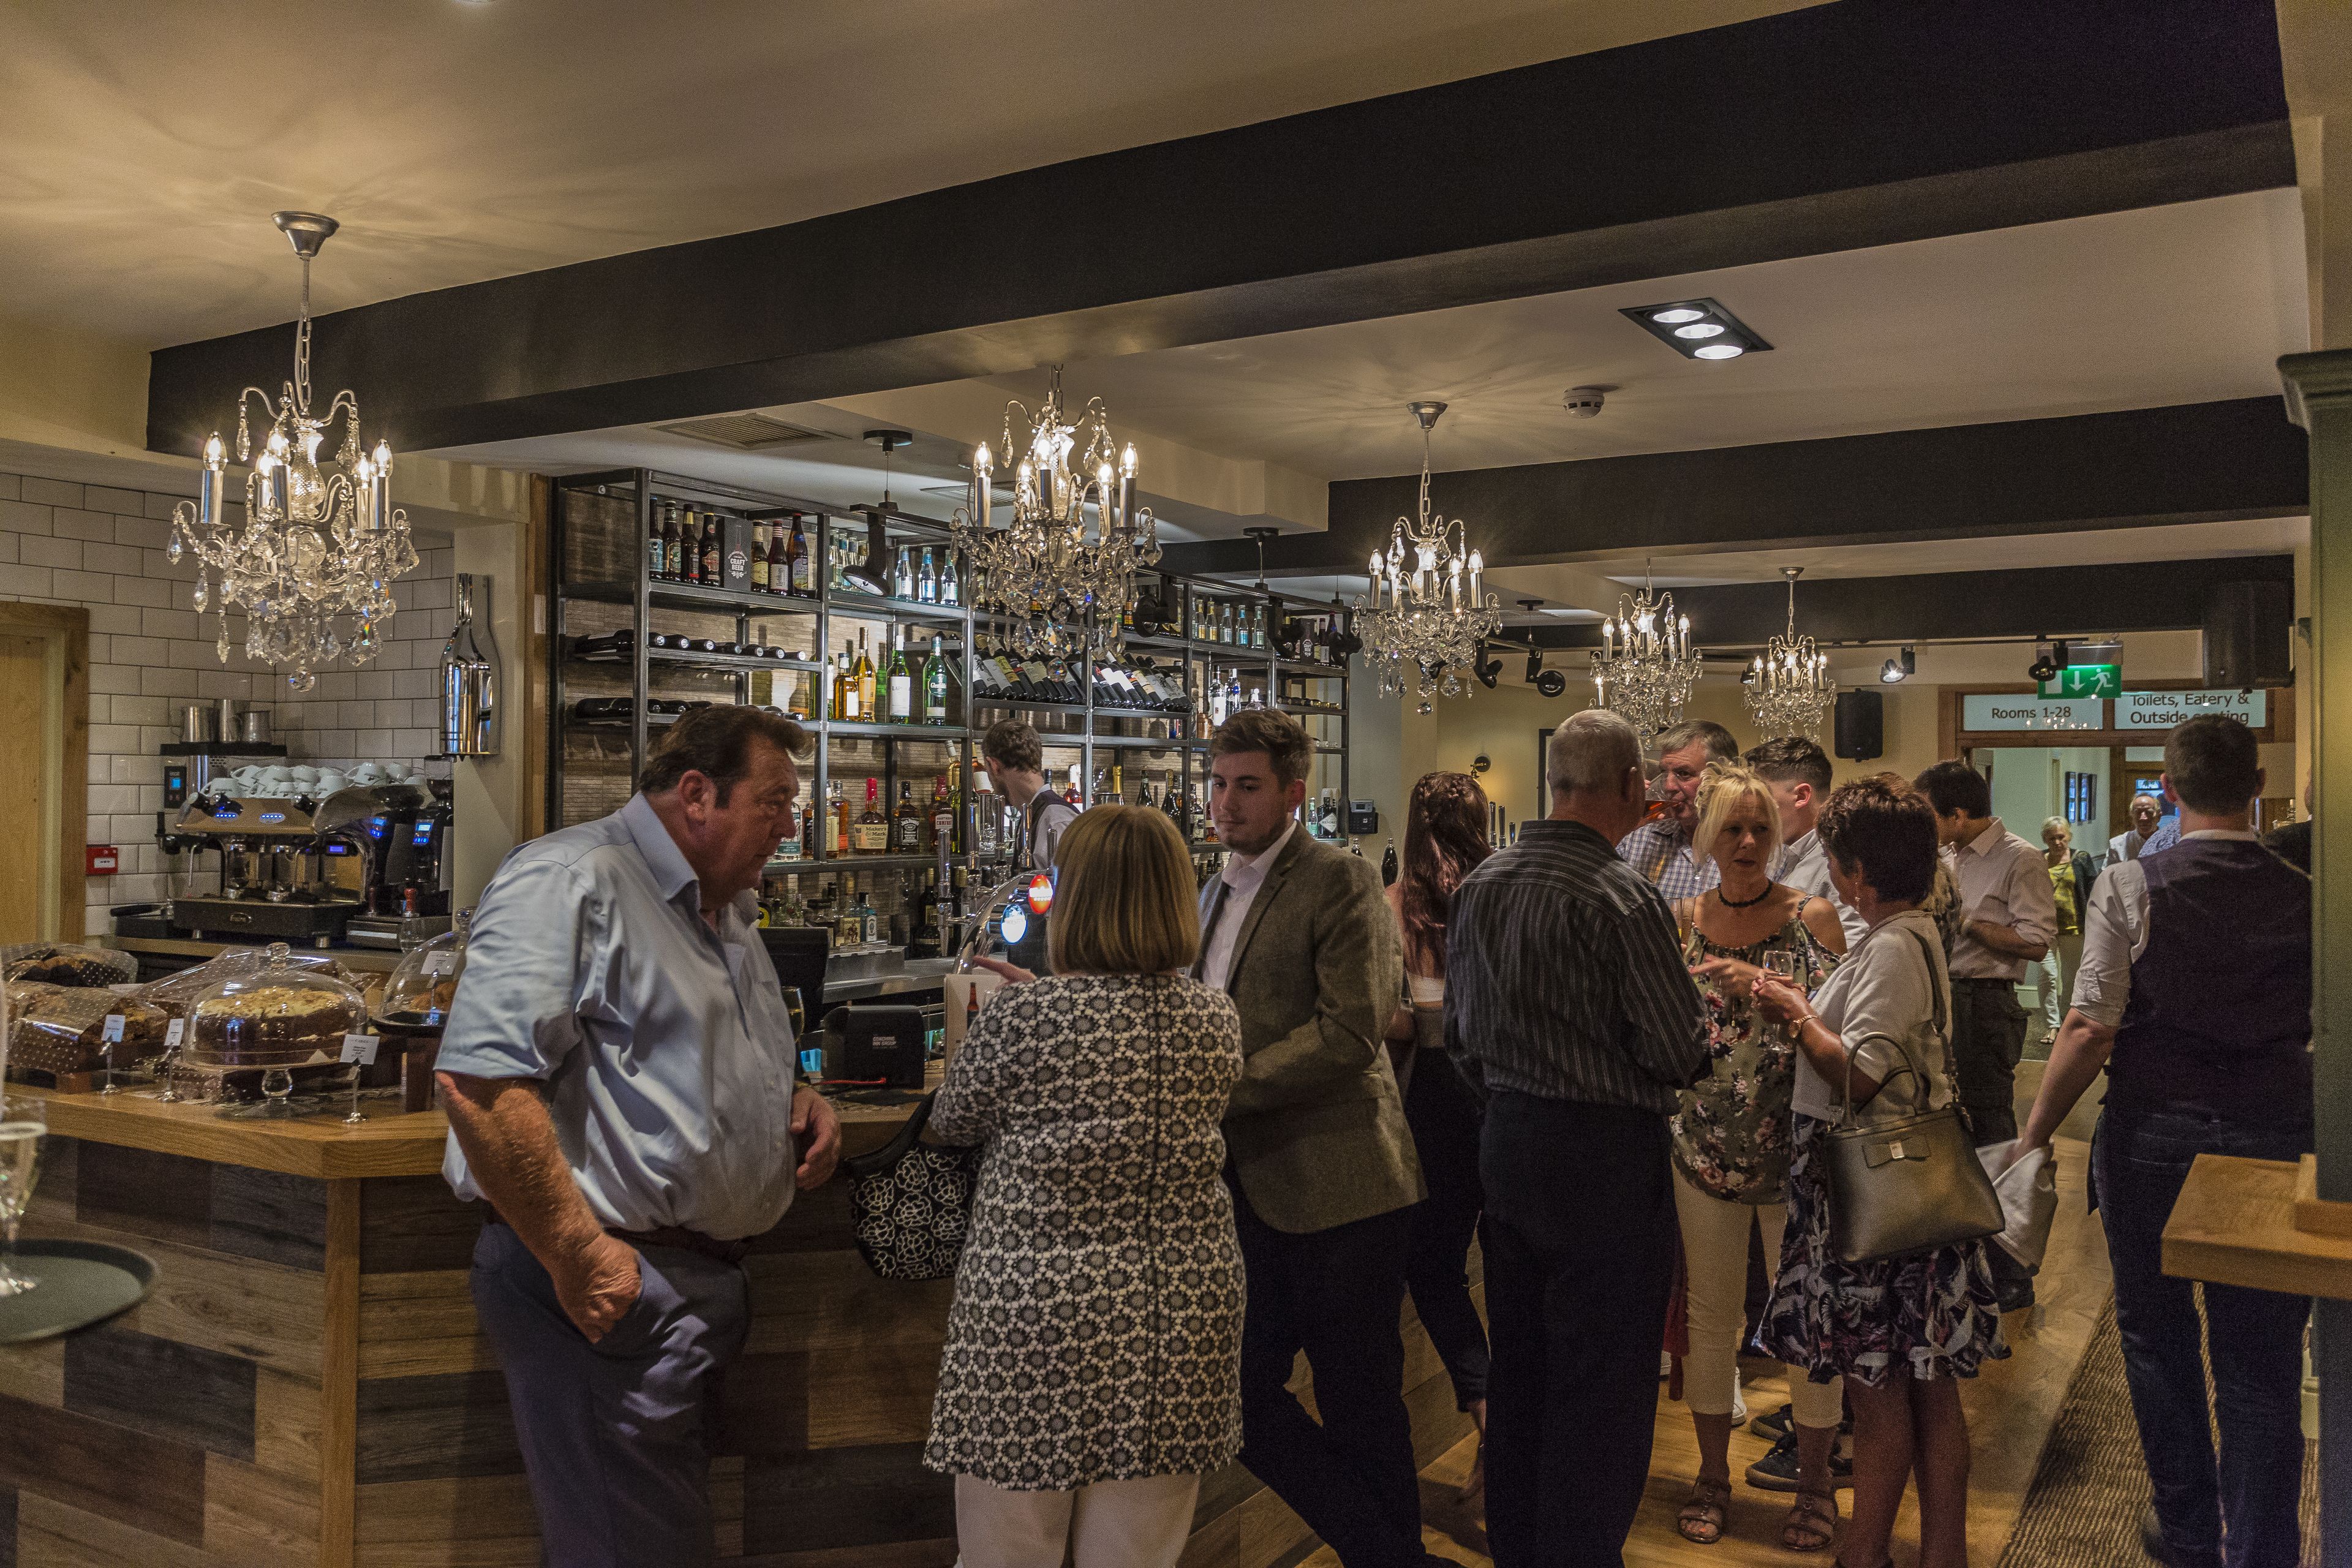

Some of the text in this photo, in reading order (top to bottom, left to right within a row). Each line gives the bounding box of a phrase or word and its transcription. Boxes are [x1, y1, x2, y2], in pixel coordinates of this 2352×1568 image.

[2130, 693, 2249, 707] Toilets, Eatery &
[1991, 706, 2071, 718] Rooms 1-28
[2130, 710, 2188, 724] Outside
